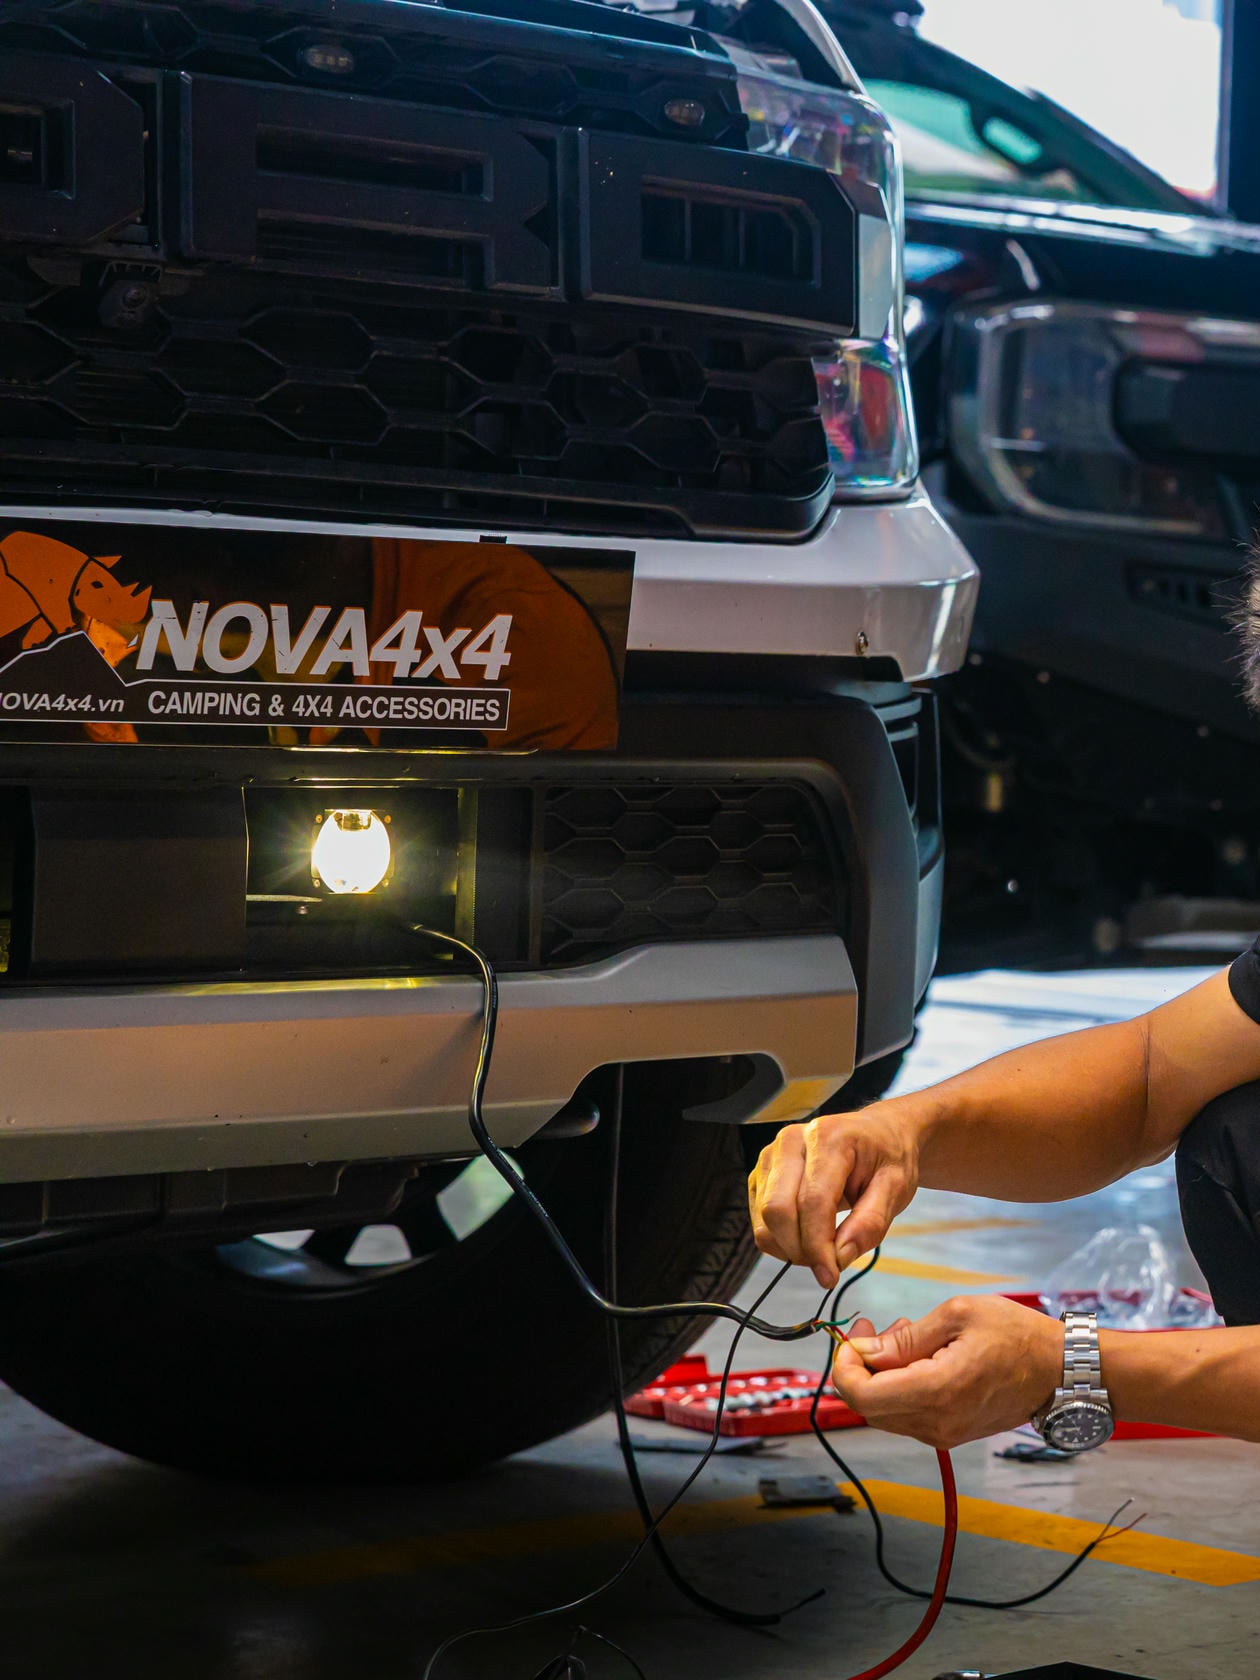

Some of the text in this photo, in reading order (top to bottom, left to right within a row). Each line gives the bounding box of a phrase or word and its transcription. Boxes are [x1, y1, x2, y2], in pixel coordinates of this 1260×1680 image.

[135, 600, 513, 681] NOVA4x4
[0, 692, 125, 713] OVA4x4.vn
[148, 690, 501, 722] CAMPING & 4X4 ACCESSORIES
